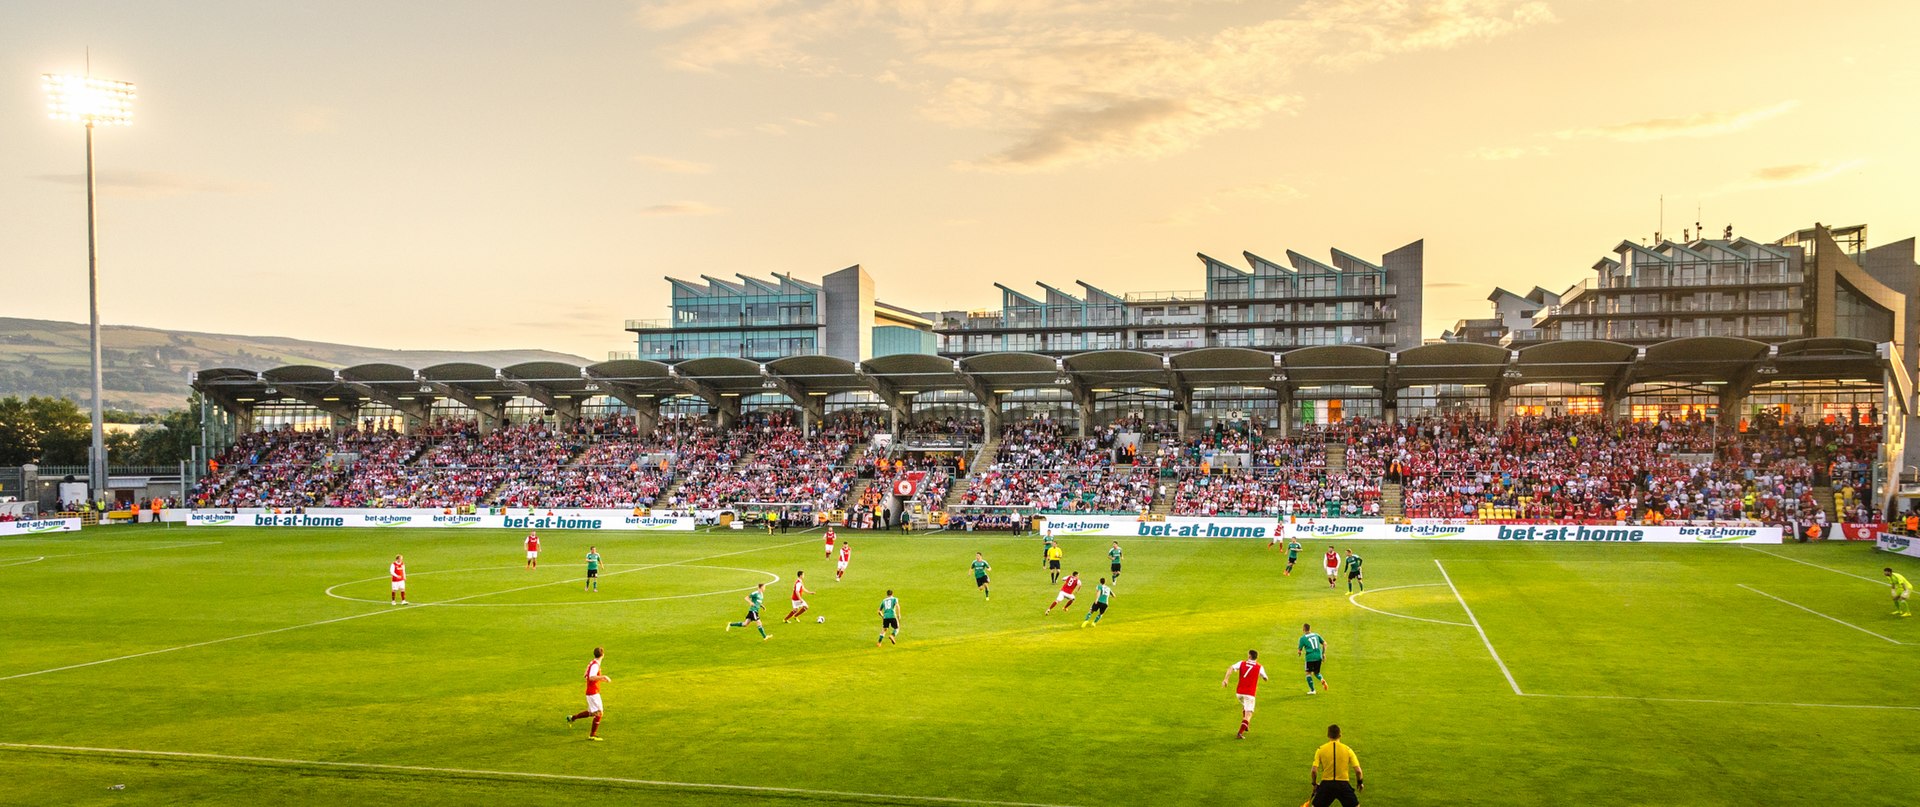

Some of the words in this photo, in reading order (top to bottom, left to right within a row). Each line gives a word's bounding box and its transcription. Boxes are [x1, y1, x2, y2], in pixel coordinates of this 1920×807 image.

[1551, 407, 1558, 416] H
[16, 520, 66, 528] bet-at-home
[255, 514, 343, 526] bet-at-home
[504, 516, 602, 529] bet-at-home
[1048, 521, 1110, 529] bet-at-home
[1138, 522, 1266, 538] bet-at-home
[1296, 524, 1364, 532] bet-at-home
[1395, 524, 1465, 532] bet-at-home
[1679, 527, 1756, 536] bet-at-home
[1498, 526, 1644, 541] bet-at-home
[1308, 637, 1318, 650] 17
[1243, 664, 1254, 678] 7
